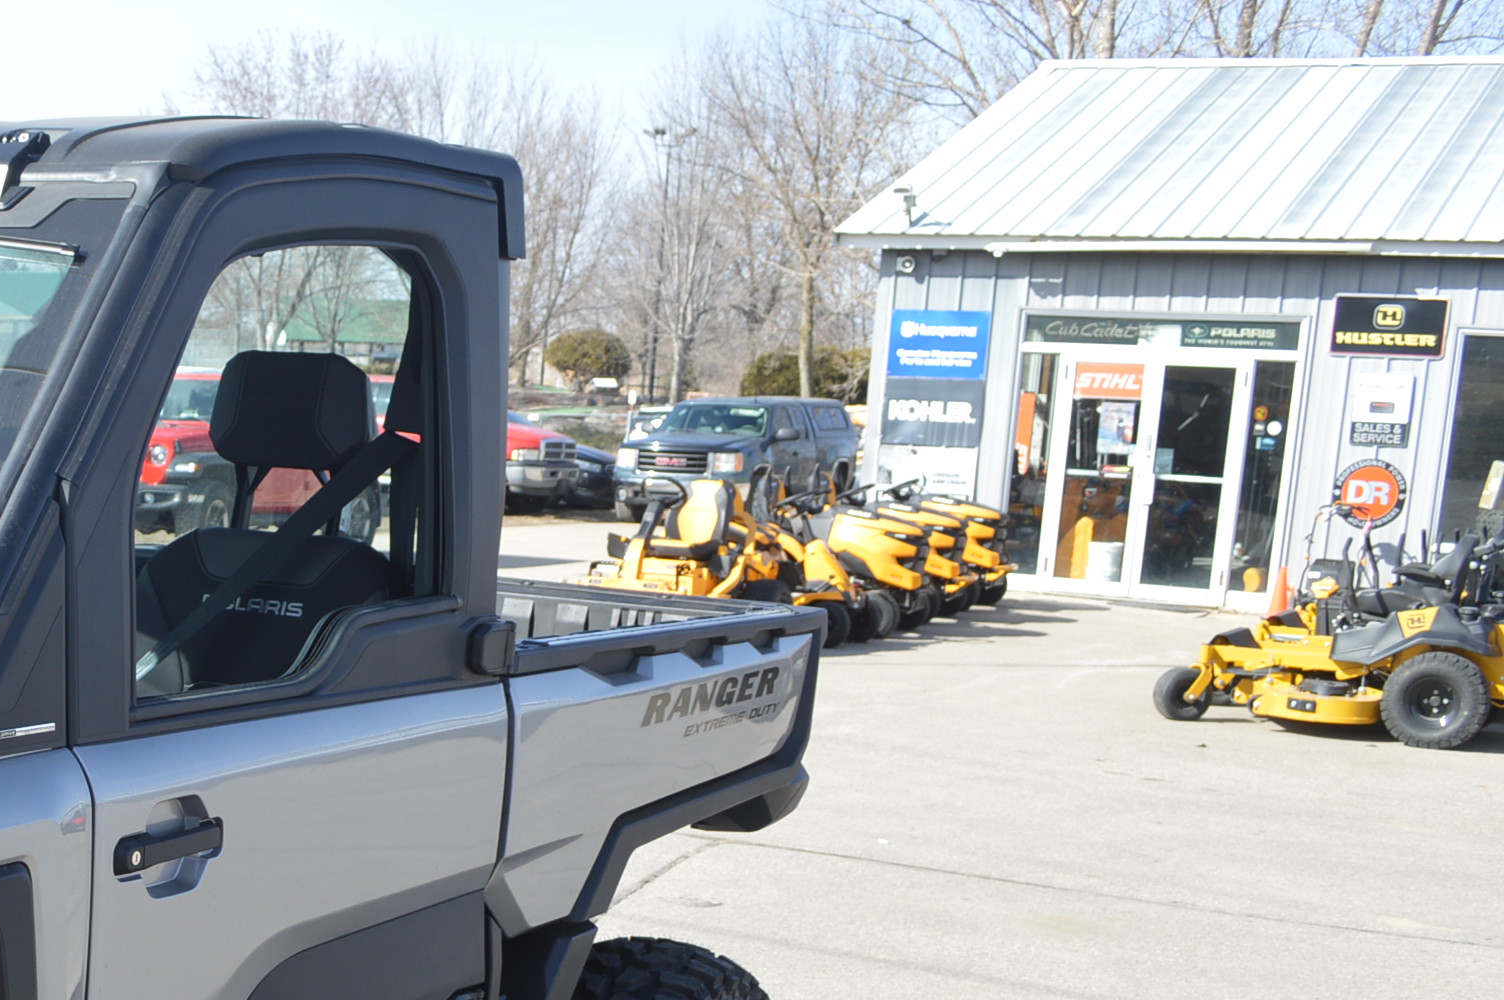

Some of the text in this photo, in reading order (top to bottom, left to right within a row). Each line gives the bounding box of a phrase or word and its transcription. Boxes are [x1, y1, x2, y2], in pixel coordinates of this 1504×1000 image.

[1045, 320, 1079, 336] Cub
[1080, 322, 1138, 339] Cadet
[1210, 327, 1276, 339] POLARIS
[1335, 331, 1438, 347] HUSTLER
[1075, 372, 1140, 390] STIHL
[1354, 422, 1402, 433] SALES &
[1352, 432, 1402, 444] SERVICE
[1346, 479, 1391, 506] DR
[640, 666, 780, 728] RANGER
[683, 702, 781, 738] EXTREME DUTY
